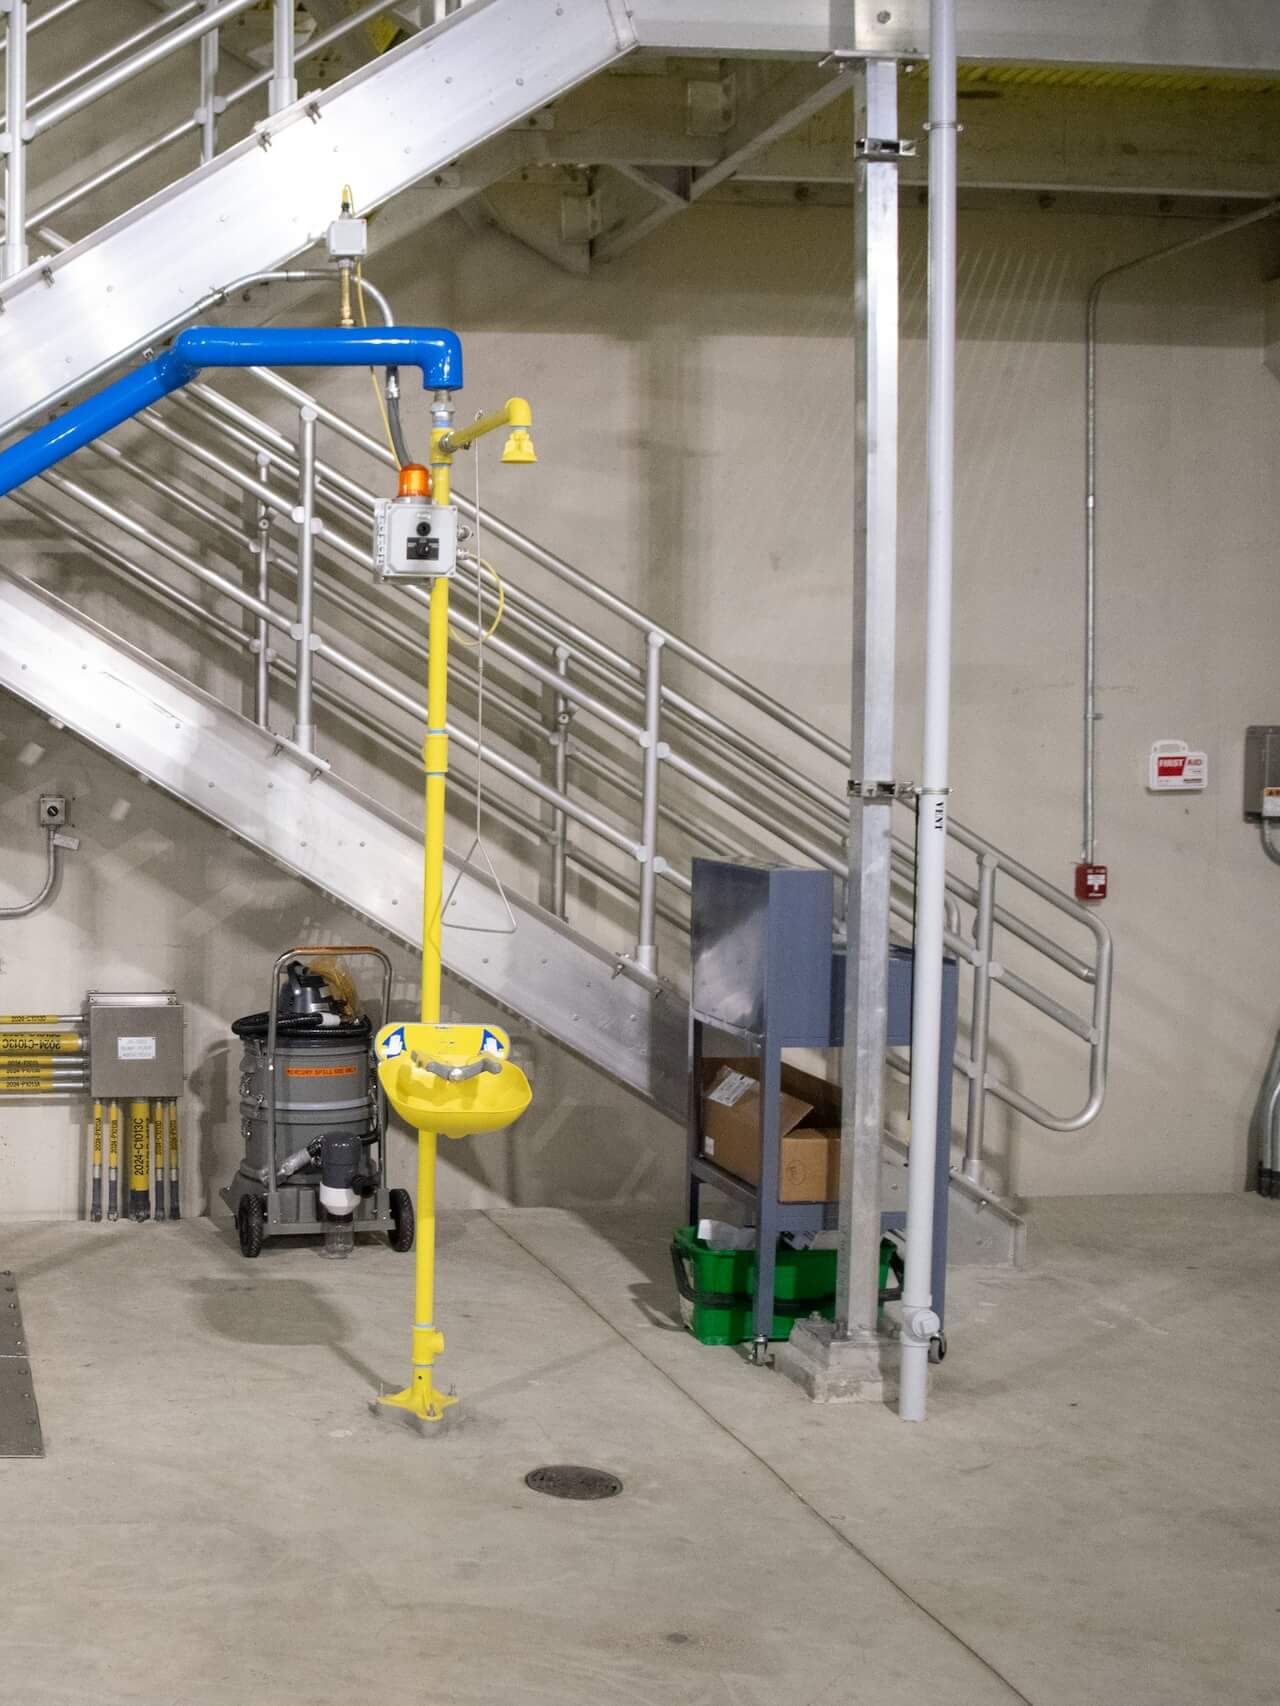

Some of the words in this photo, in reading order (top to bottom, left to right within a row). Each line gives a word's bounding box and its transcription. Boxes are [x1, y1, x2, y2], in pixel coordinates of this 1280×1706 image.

[1159, 759, 1184, 767] FIRST
[935, 801, 944, 831] VENT
[2, 1038, 61, 1050] 2024-C1013C
[134, 1118, 144, 1176] 2024-C1013C
